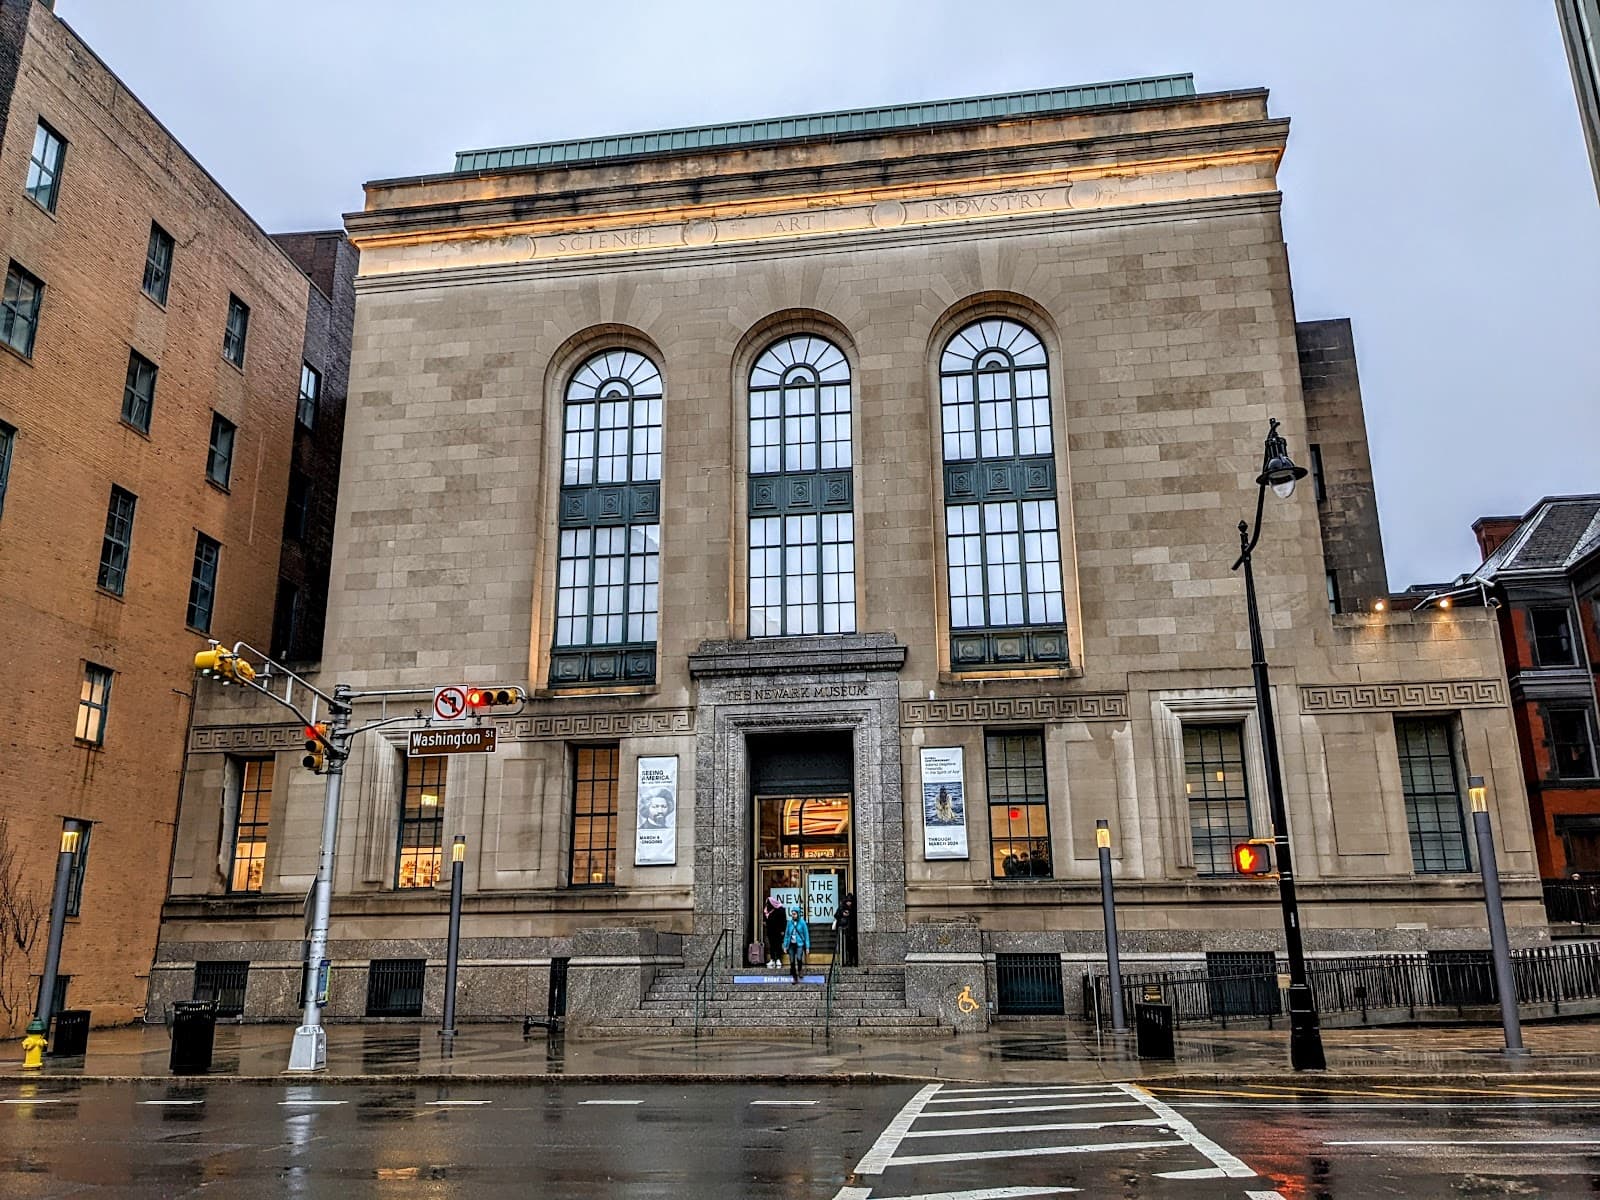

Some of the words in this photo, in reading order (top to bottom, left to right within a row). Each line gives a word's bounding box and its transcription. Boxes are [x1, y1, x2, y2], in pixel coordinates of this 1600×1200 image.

[924, 193, 1047, 218] INDVSTRY
[773, 215, 816, 232] ART
[558, 229, 657, 252] SCIENCE
[727, 690, 751, 701] THE
[755, 687, 810, 700] NEWARK
[814, 685, 869, 698] MUSEUM
[412, 731, 480, 749] Washington
[485, 730, 494, 738] St
[810, 880, 833, 891] THE
[776, 893, 833, 905] NEWARK
